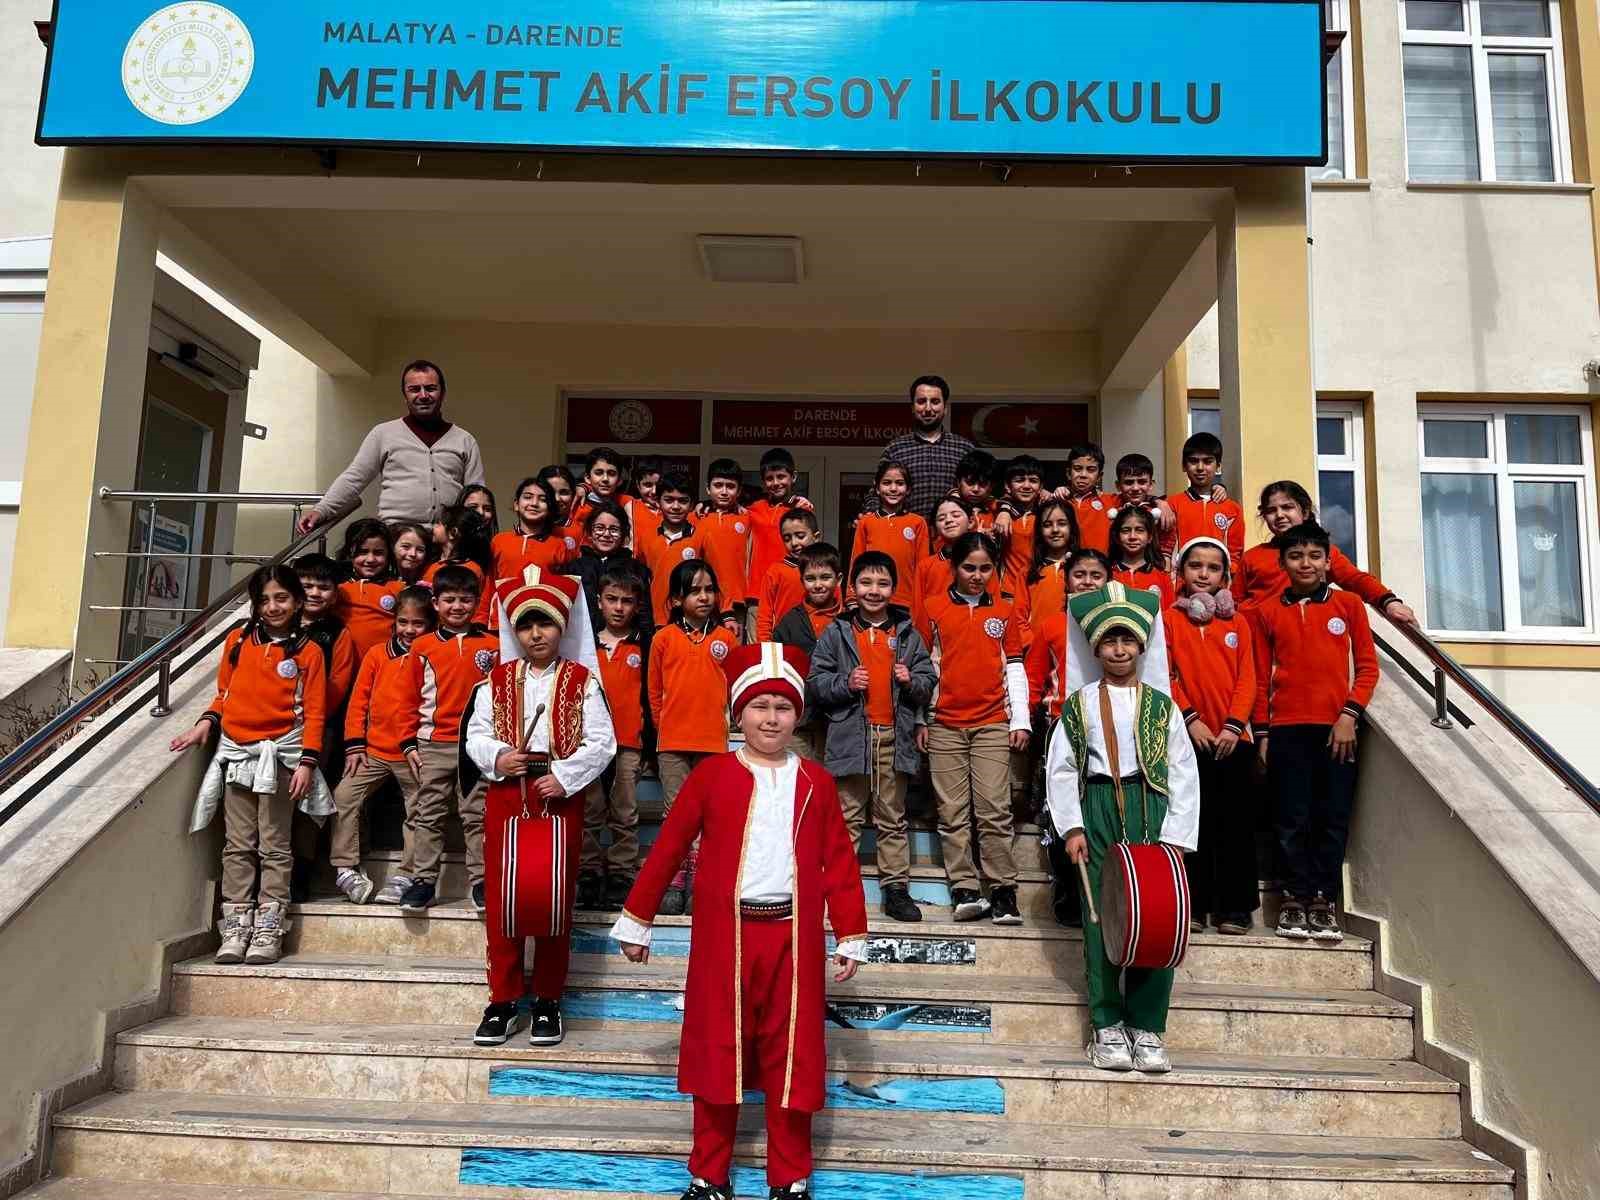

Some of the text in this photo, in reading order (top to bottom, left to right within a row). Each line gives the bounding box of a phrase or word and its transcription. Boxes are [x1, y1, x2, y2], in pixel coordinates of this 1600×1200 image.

[323, 22, 457, 45] MALATYA
[485, 24, 623, 48] DARENDE
[316, 64, 1221, 124] MEHMET AKİF ERSOY İLKOKULU
[794, 408, 857, 421] DARENDE
[723, 424, 780, 439] MEHMET
[816, 425, 860, 439] ERSOY
